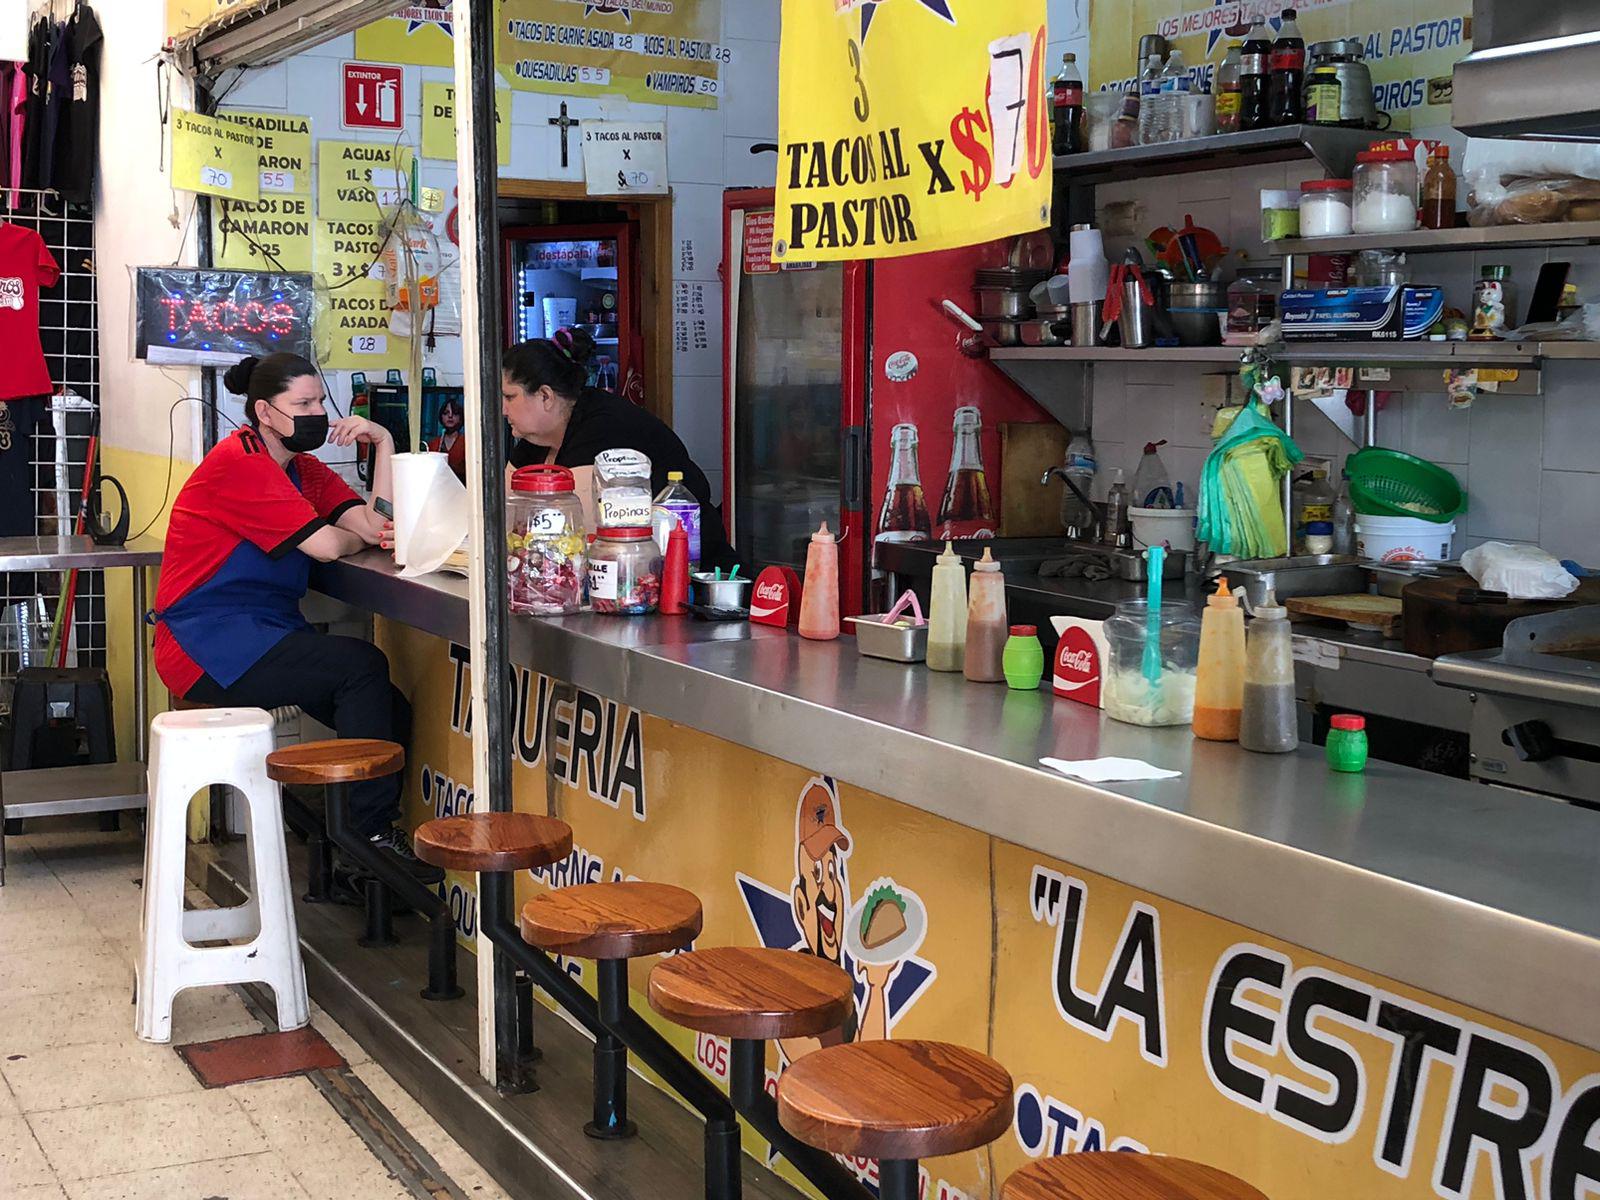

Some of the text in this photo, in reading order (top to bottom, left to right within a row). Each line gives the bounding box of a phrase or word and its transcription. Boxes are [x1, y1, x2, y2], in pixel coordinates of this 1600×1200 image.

[444, 11, 454, 22] DE
[1157, 18, 1179, 37] LOS
[1181, 6, 1238, 33] MEJORES
[515, 21, 731, 63] TACOS DE CARNE ASADA 28 ACOS AL PASTOR 28
[1364, 33, 1383, 60] AL
[1389, 18, 1462, 57] PASTOR
[347, 71, 382, 81] EXTINTOR
[522, 61, 578, 82] QUESADILLAS
[652, 73, 695, 94] VAMPIROS
[699, 82, 717, 92] 50
[848, 38, 870, 123] 3
[1374, 79, 1425, 111] PIROS
[176, 118, 255, 146] 3 TACOS AL PASTOR
[586, 131, 662, 141] 3 TACOS AL PASTOR
[258, 155, 302, 170] ARON
[342, 148, 391, 162] AGUAS
[786, 134, 877, 189] TACOS
[878, 127, 911, 180] AL
[917, 139, 956, 195] X
[208, 168, 228, 186] 70
[263, 172, 285, 187] 55
[346, 168, 372, 182] 1L $
[337, 187, 376, 203] VASO
[282, 201, 305, 214] DE
[219, 219, 309, 236] CAMARON
[327, 221, 374, 236] TACOS
[788, 193, 918, 250] PASTOR
[334, 240, 381, 254] PASTO
[333, 262, 342, 277] 3
[331, 297, 390, 311] TACOS D
[160, 298, 294, 334] TACOS
[340, 316, 389, 329] ASADA
[359, 337, 376, 351] 28
[603, 502, 651, 520] Propinas
[448, 642, 646, 817] TUERIA
[434, 775, 475, 818] TAC
